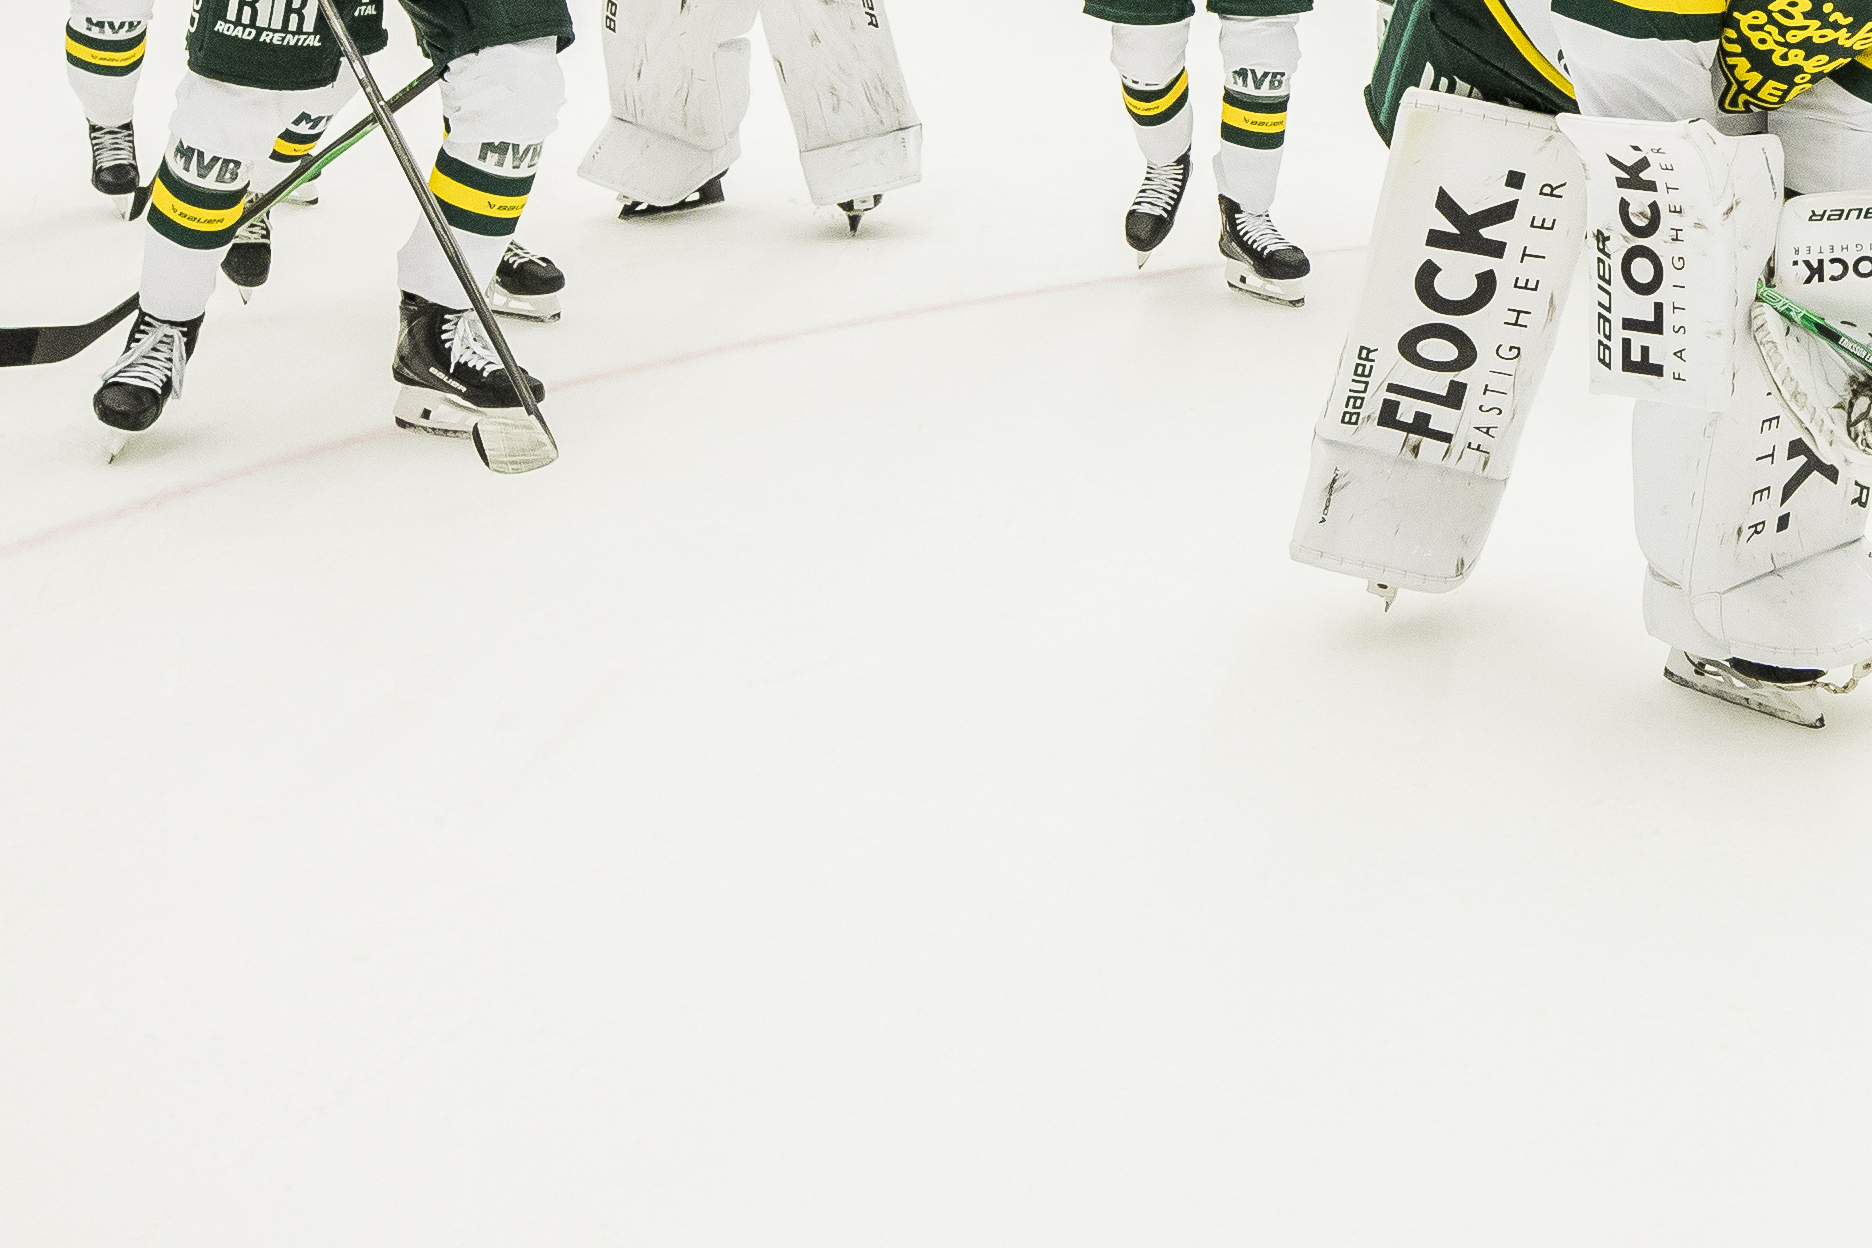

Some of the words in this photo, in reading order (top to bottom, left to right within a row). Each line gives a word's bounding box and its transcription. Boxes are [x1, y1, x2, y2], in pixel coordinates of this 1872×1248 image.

[214, 20, 257, 40] ROAD
[259, 31, 322, 47] RENTAL
[1376, 169, 1526, 444] FLOCK.
[1466, 181, 1567, 454] FASTIGHETER
[1597, 229, 1613, 370] BAUER
[1605, 144, 1664, 377] FLOCK.
[1650, 145, 1687, 382] FASTIGHETER
[1340, 344, 1379, 426] BAUER
